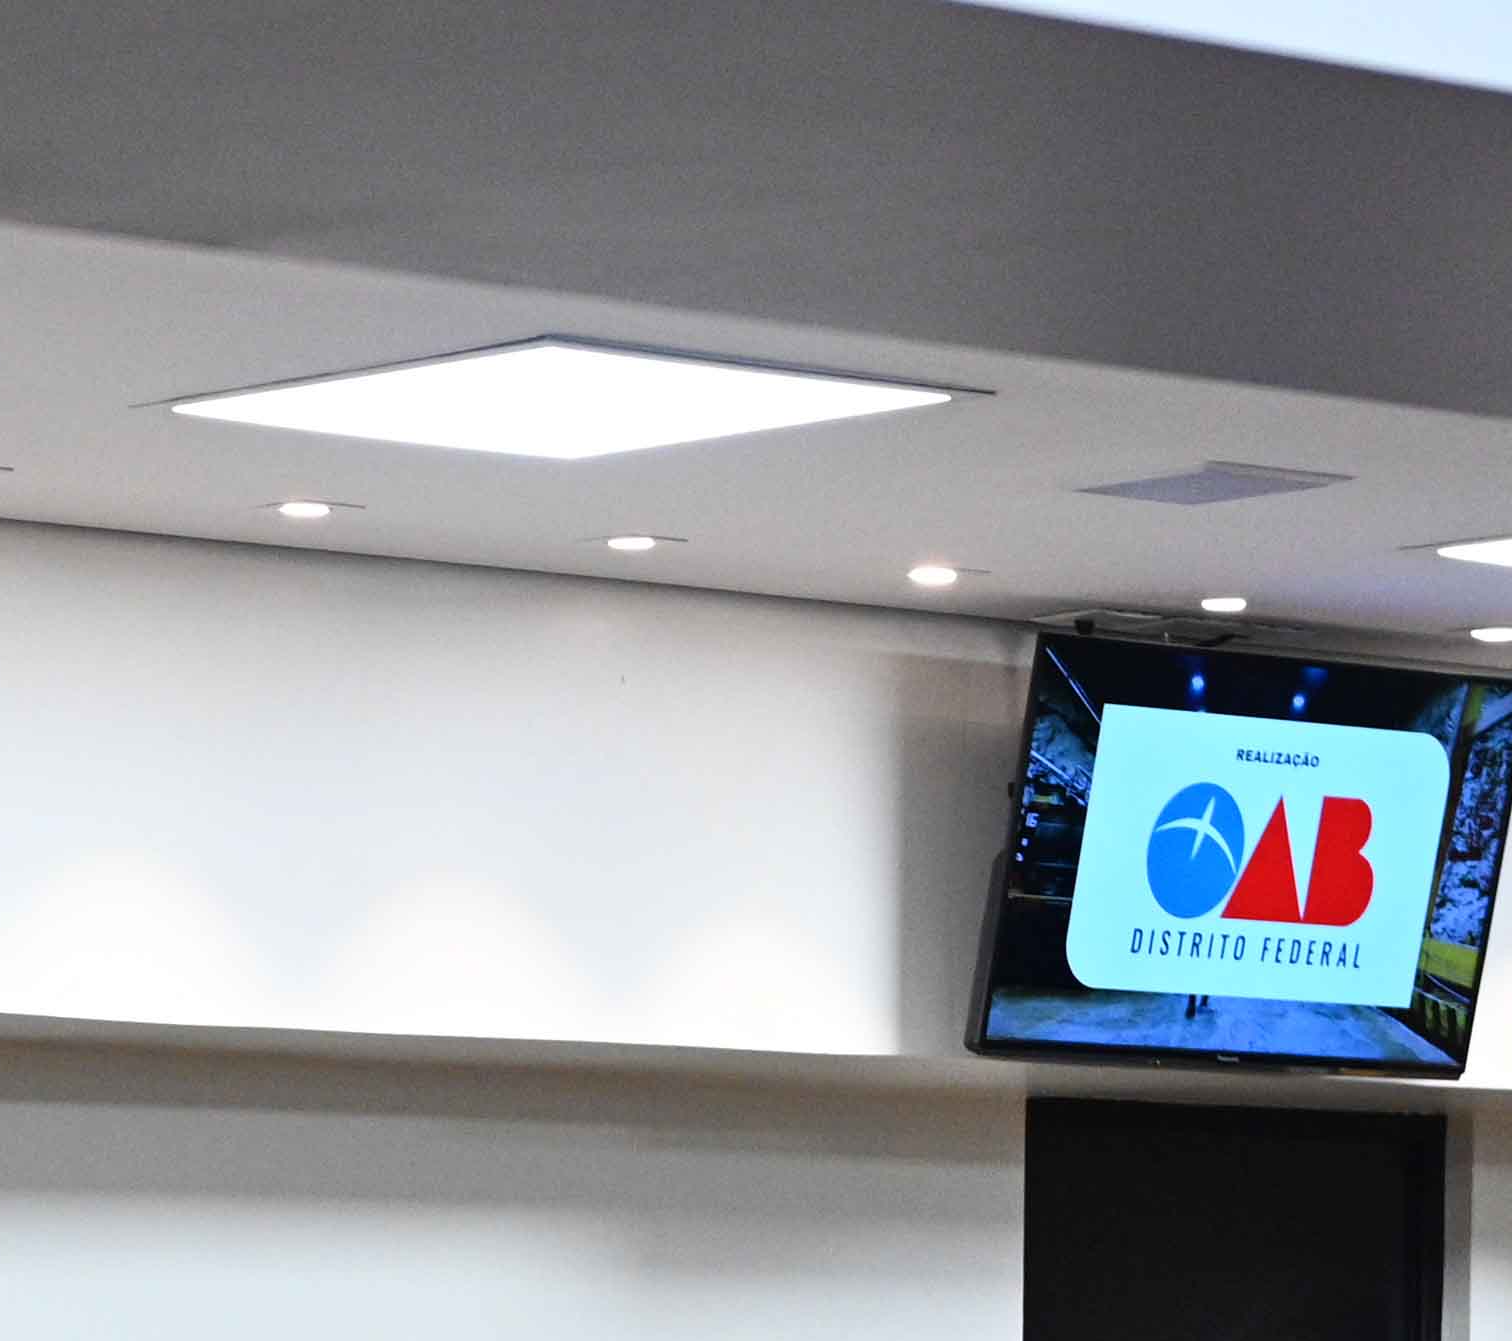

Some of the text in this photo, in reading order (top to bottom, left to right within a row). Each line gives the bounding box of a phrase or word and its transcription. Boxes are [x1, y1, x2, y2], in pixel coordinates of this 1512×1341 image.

[1236, 748, 1320, 768] REALIZAÇÃO
[1146, 781, 1374, 927] OAB
[1130, 928, 1360, 968] DISTRITO FEDERAL
